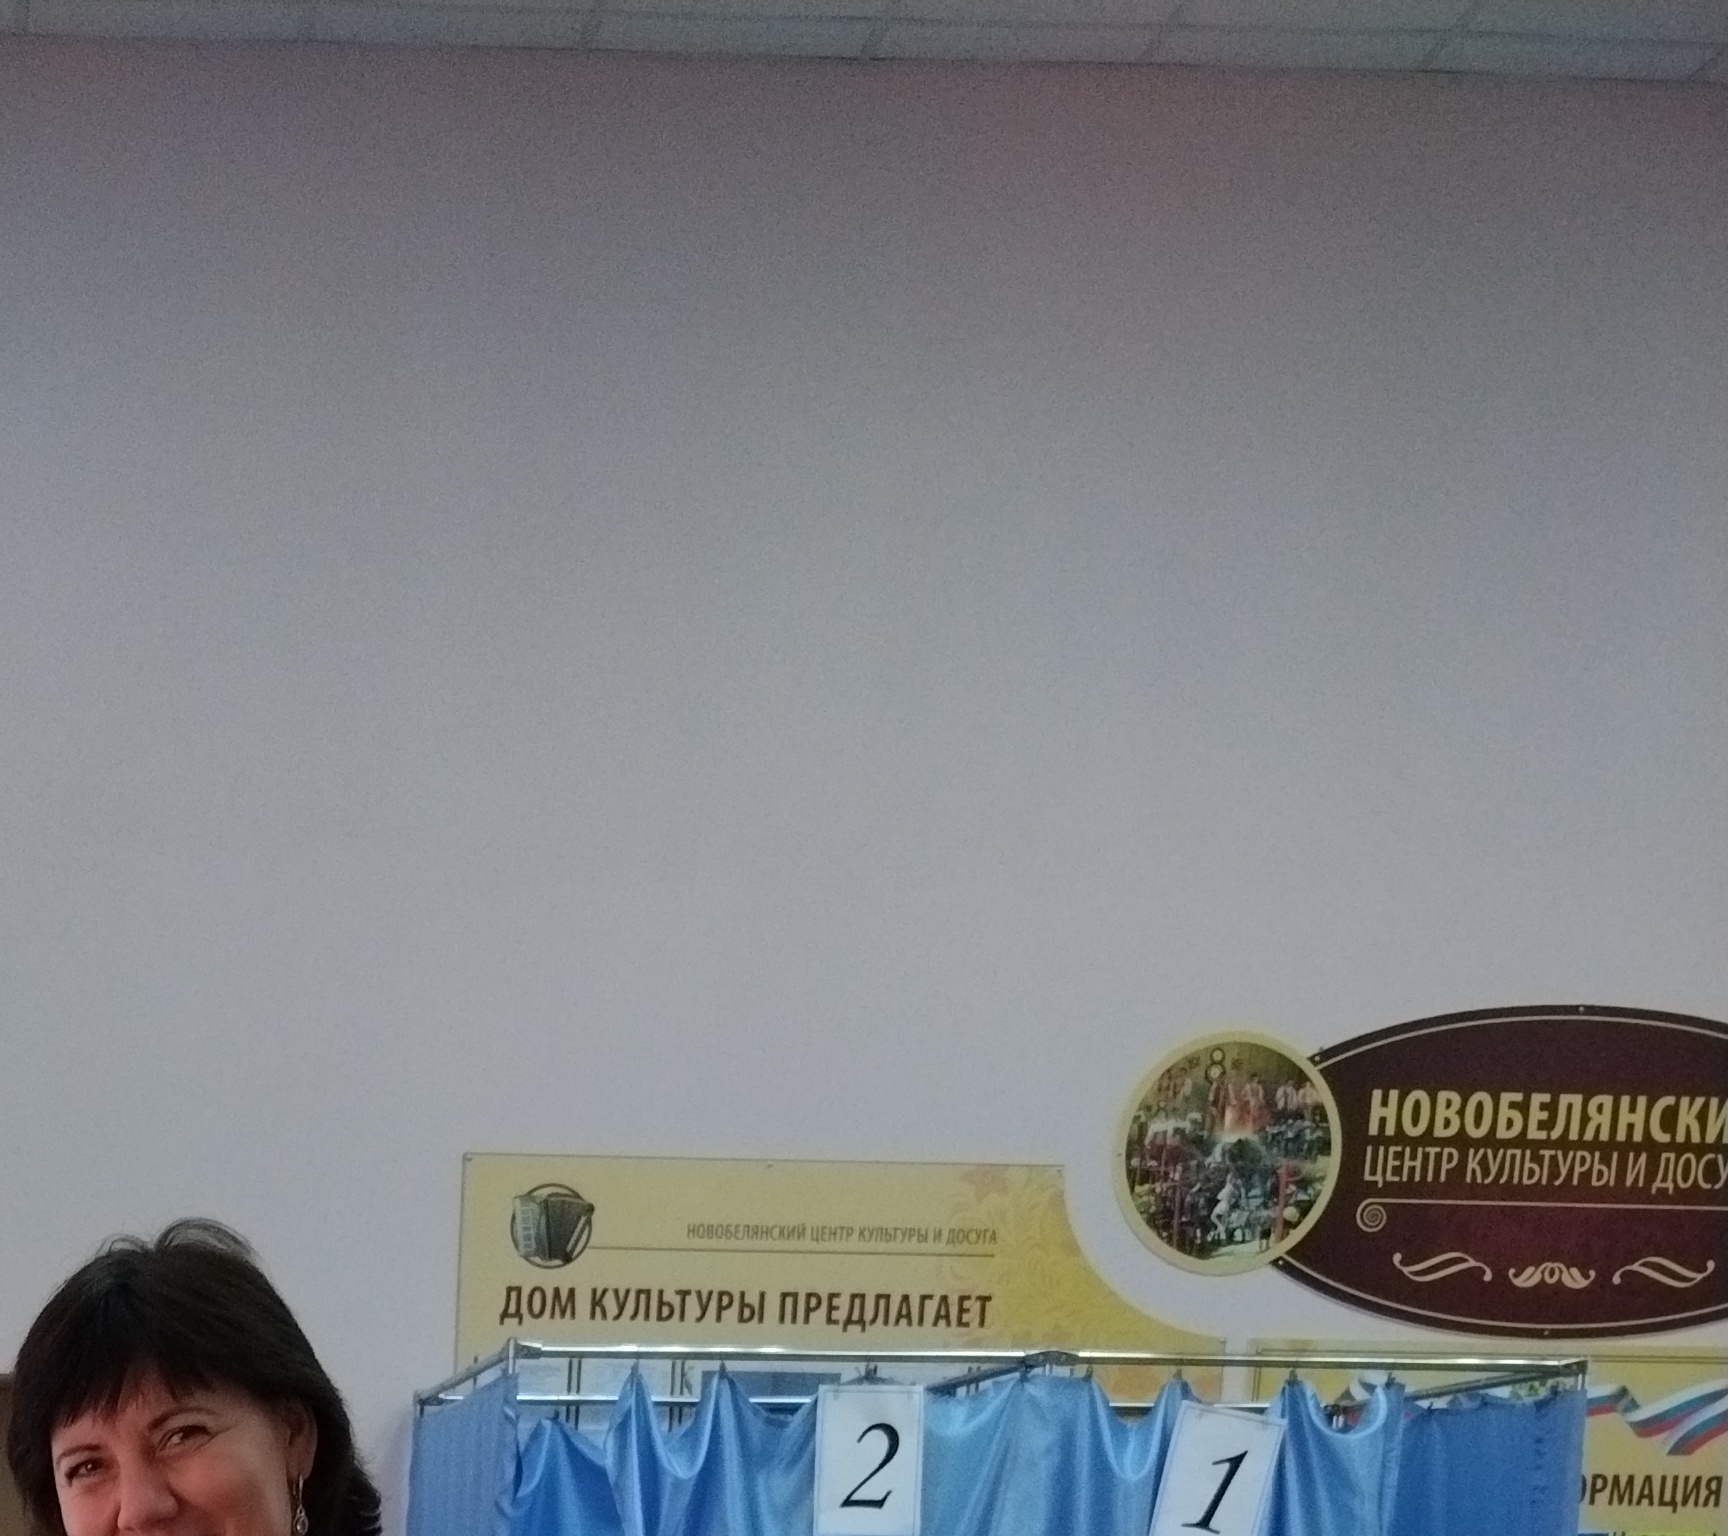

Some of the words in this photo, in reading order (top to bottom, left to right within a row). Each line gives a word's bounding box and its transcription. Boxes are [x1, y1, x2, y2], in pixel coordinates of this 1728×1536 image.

[1363, 1145, 1459, 1188] ЦЕНТР
[1465, 1147, 1619, 1187] КУЛЬТУРЫ
[1625, 1151, 1647, 1188] И
[686, 1222, 806, 1242] НОВОБЕЛЯНСКИЙ
[810, 1224, 855, 1244] ЦЕНТР
[858, 1226, 929, 1244] КУЛЬТУРЫ
[932, 1227, 943, 1244] И
[946, 1227, 998, 1246] ДОСУГА
[498, 1285, 576, 1326] ДОМ
[589, 1287, 766, 1325] КУЛЬТУРЫ
[778, 1291, 993, 1332] ПРЕДЛАГАЕТ
[839, 1422, 901, 1510] 2
[1181, 1450, 1249, 1535] 1
